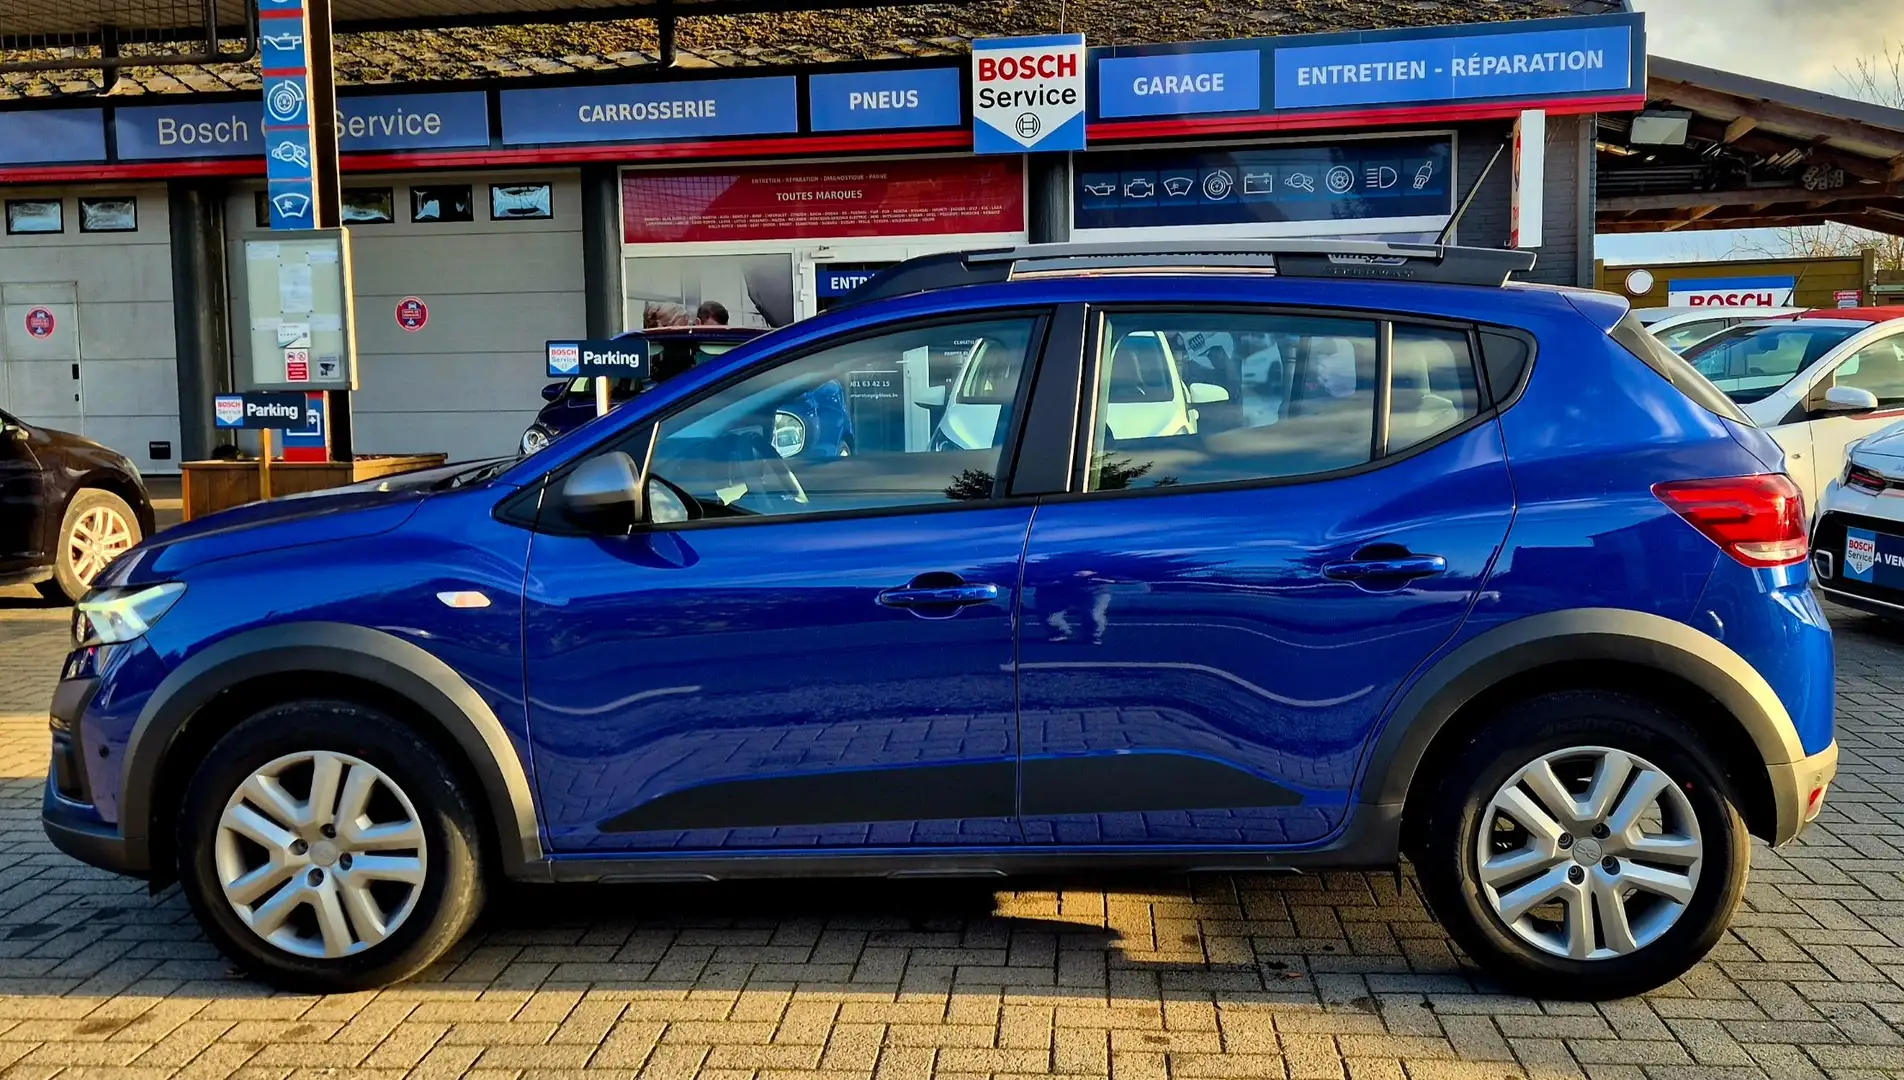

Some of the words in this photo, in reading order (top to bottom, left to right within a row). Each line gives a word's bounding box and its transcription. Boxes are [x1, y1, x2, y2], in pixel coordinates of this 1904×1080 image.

[978, 53, 1076, 81] BOSCH
[1297, 60, 1425, 86] ENTRETIEN
[1451, 50, 1603, 77] RÉPARATION
[1133, 73, 1224, 96] GARAGE
[850, 90, 919, 110] PNEUS
[979, 84, 1077, 109] Service
[578, 100, 716, 123] CARROSSERIE
[157, 115, 248, 145] Bosch
[776, 191, 813, 202] TOUTES
[815, 189, 863, 201] MARQUES
[1689, 292, 1773, 307] BOSCH
[551, 348, 577, 356] BOSCH
[583, 350, 640, 368] Parking
[246, 403, 299, 420] Parking
[1848, 539, 1874, 552] BOSCH
[1848, 549, 1872, 563] Service
[1874, 551, 1882, 563] A
